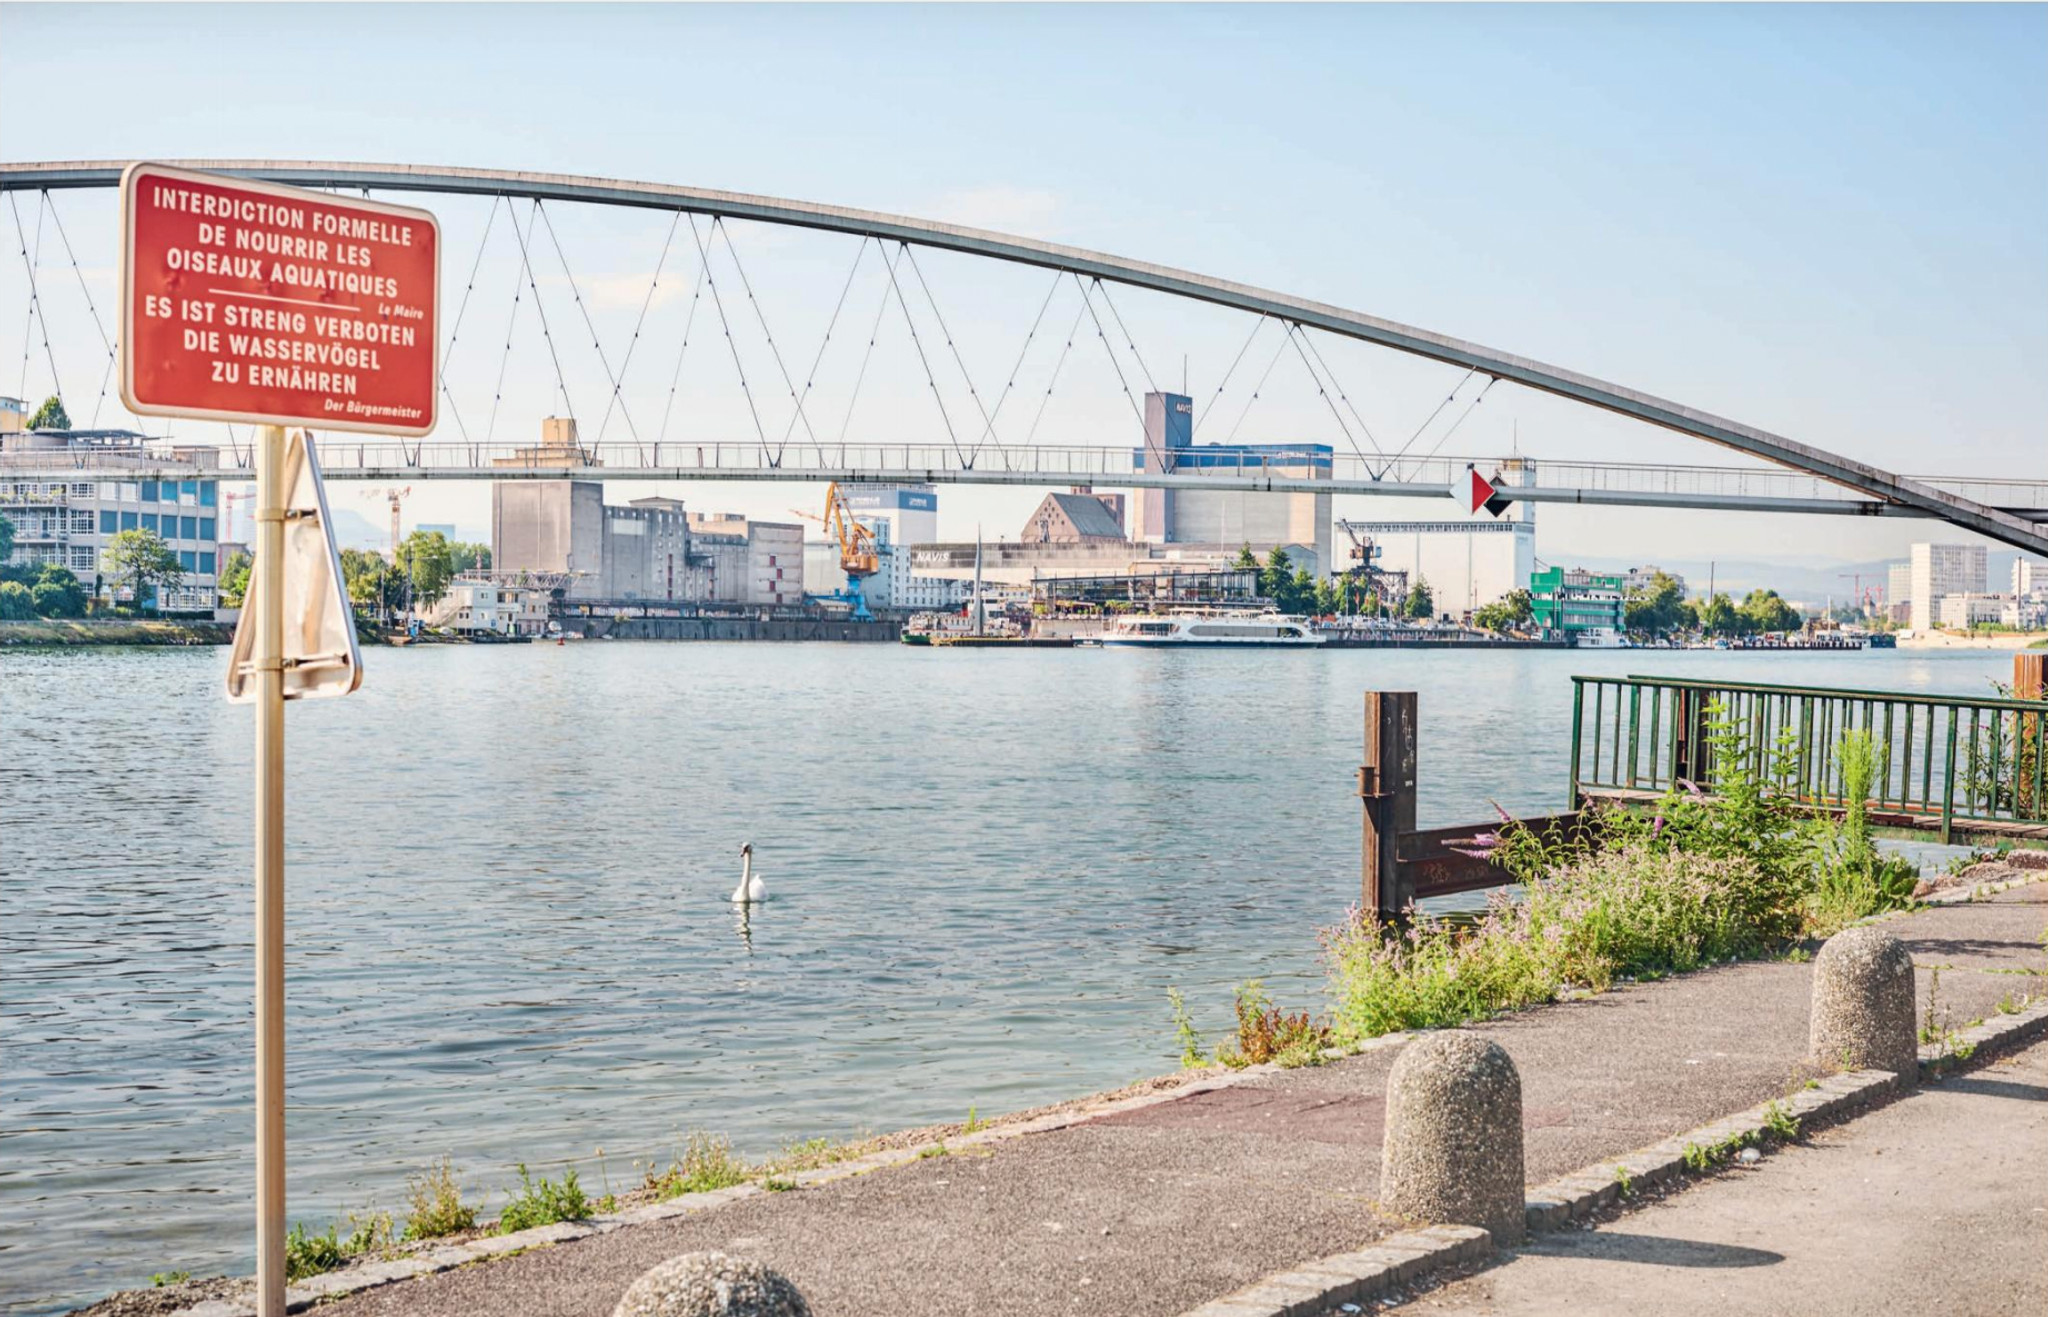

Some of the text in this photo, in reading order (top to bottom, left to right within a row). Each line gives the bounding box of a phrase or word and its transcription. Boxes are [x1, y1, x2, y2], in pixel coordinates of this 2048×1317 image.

[154, 187, 412, 246] INTERDICTION FORMELLE
[199, 223, 371, 267] DE NOURRIR LES
[167, 248, 398, 298] OISEAUX AQUATIQUES
[146, 295, 414, 347] ES IST STRENG VERBOTEN
[379, 303, 424, 320] Le Maire
[184, 329, 381, 370] DIE WASSERVÖGEL
[212, 361, 357, 394] ZU ERNÄHREN
[324, 399, 422, 419] Der Bürgermeister
[916, 551, 950, 562] NAVIS
